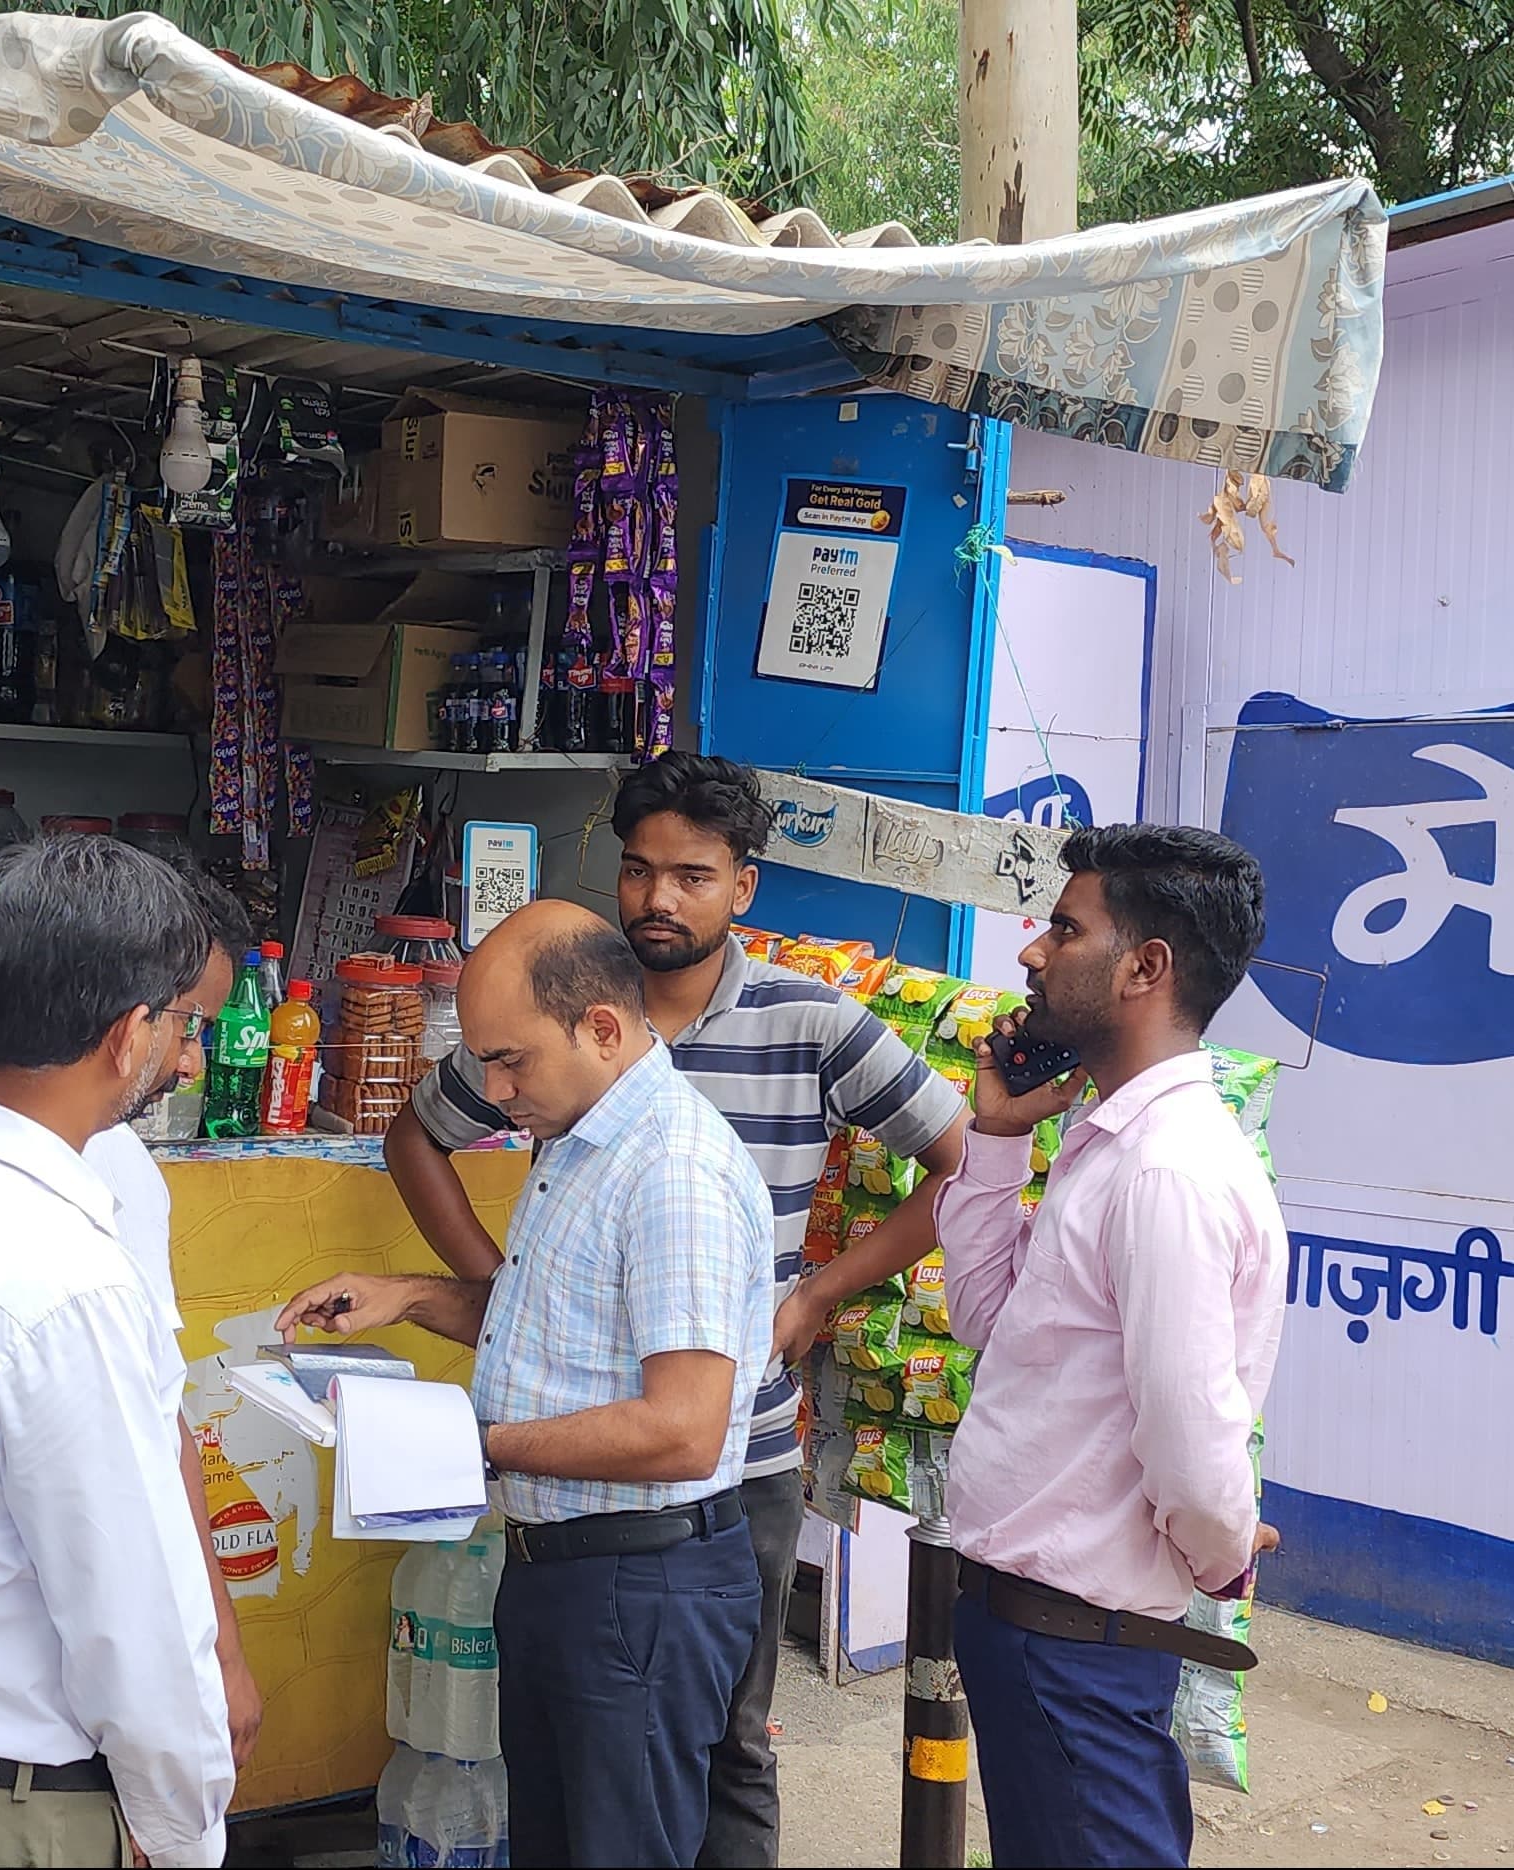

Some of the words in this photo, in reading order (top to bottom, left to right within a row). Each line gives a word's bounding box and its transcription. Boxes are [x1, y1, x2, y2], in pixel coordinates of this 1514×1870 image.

[809, 494, 828, 506] Get
[830, 496, 854, 509] Real
[856, 498, 882, 510] Gold
[812, 546, 859, 565] paytm
[810, 563, 857, 578] Preferred
[1286, 1226, 1514, 1345] ाज़गी
[909, 1356, 942, 1376] Lay's
[202, 1470, 235, 1486] ame
[212, 1533, 241, 1552] OLD
[246, 1528, 279, 1546] FLA
[451, 1633, 495, 1655] Bisleri
